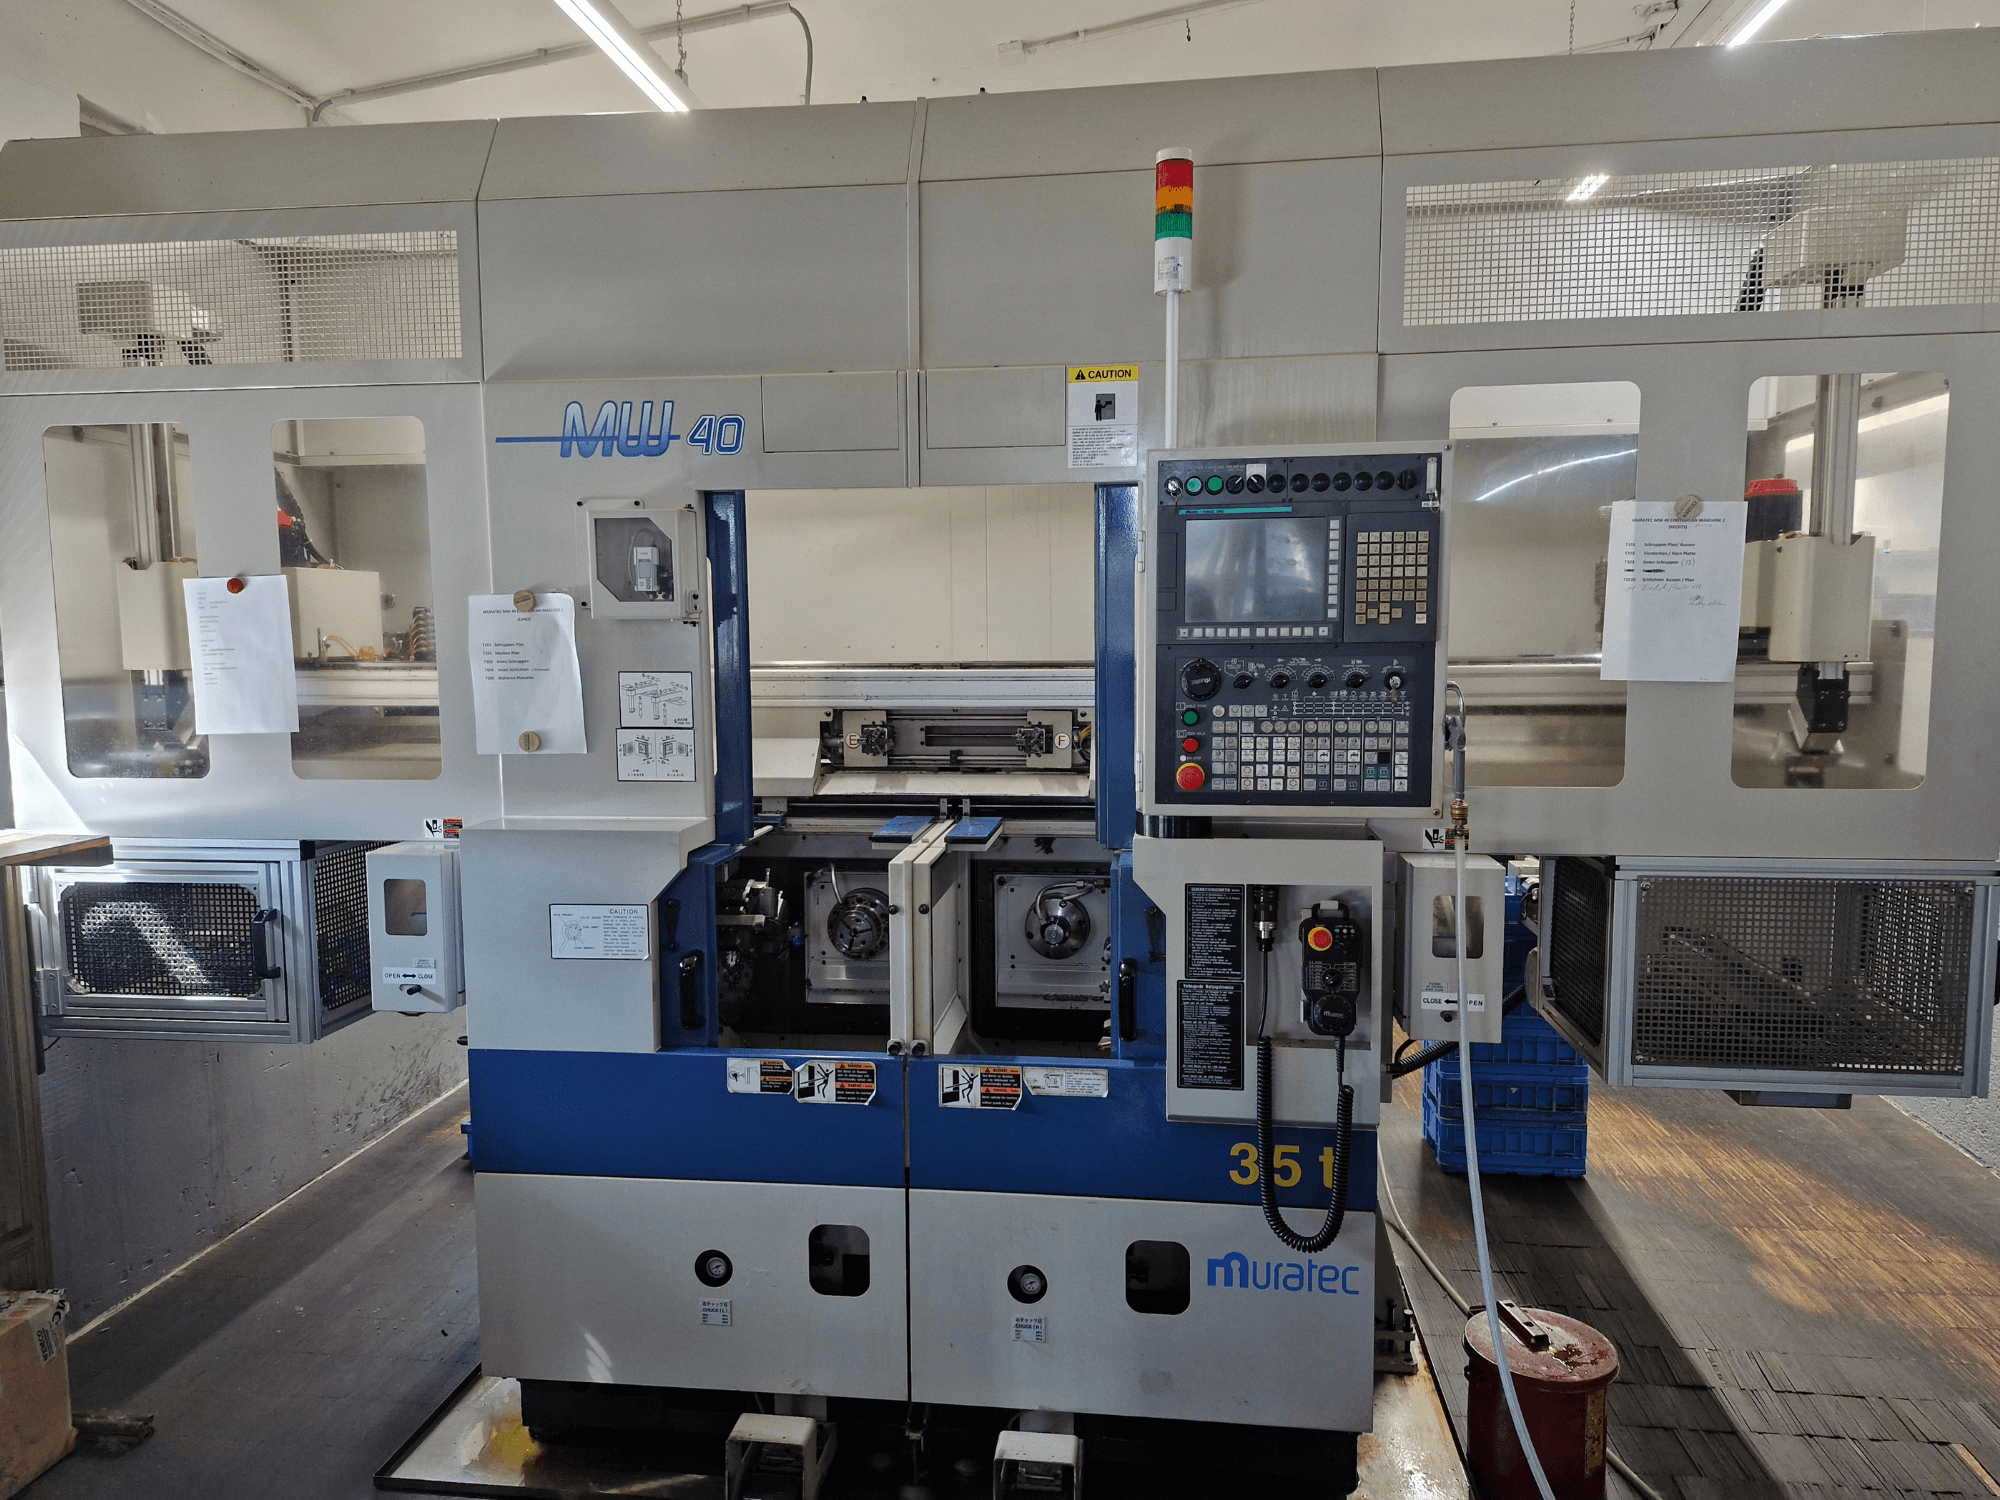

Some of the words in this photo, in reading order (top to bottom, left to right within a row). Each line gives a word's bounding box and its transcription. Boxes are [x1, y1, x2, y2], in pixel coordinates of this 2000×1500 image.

[1088, 369, 1132, 379] CAUTION
[560, 400, 675, 458] MW
[686, 414, 746, 456] 40
[848, 734, 857, 746] E
[1058, 735, 1067, 747] F
[1319, 1146, 1334, 1189] t
